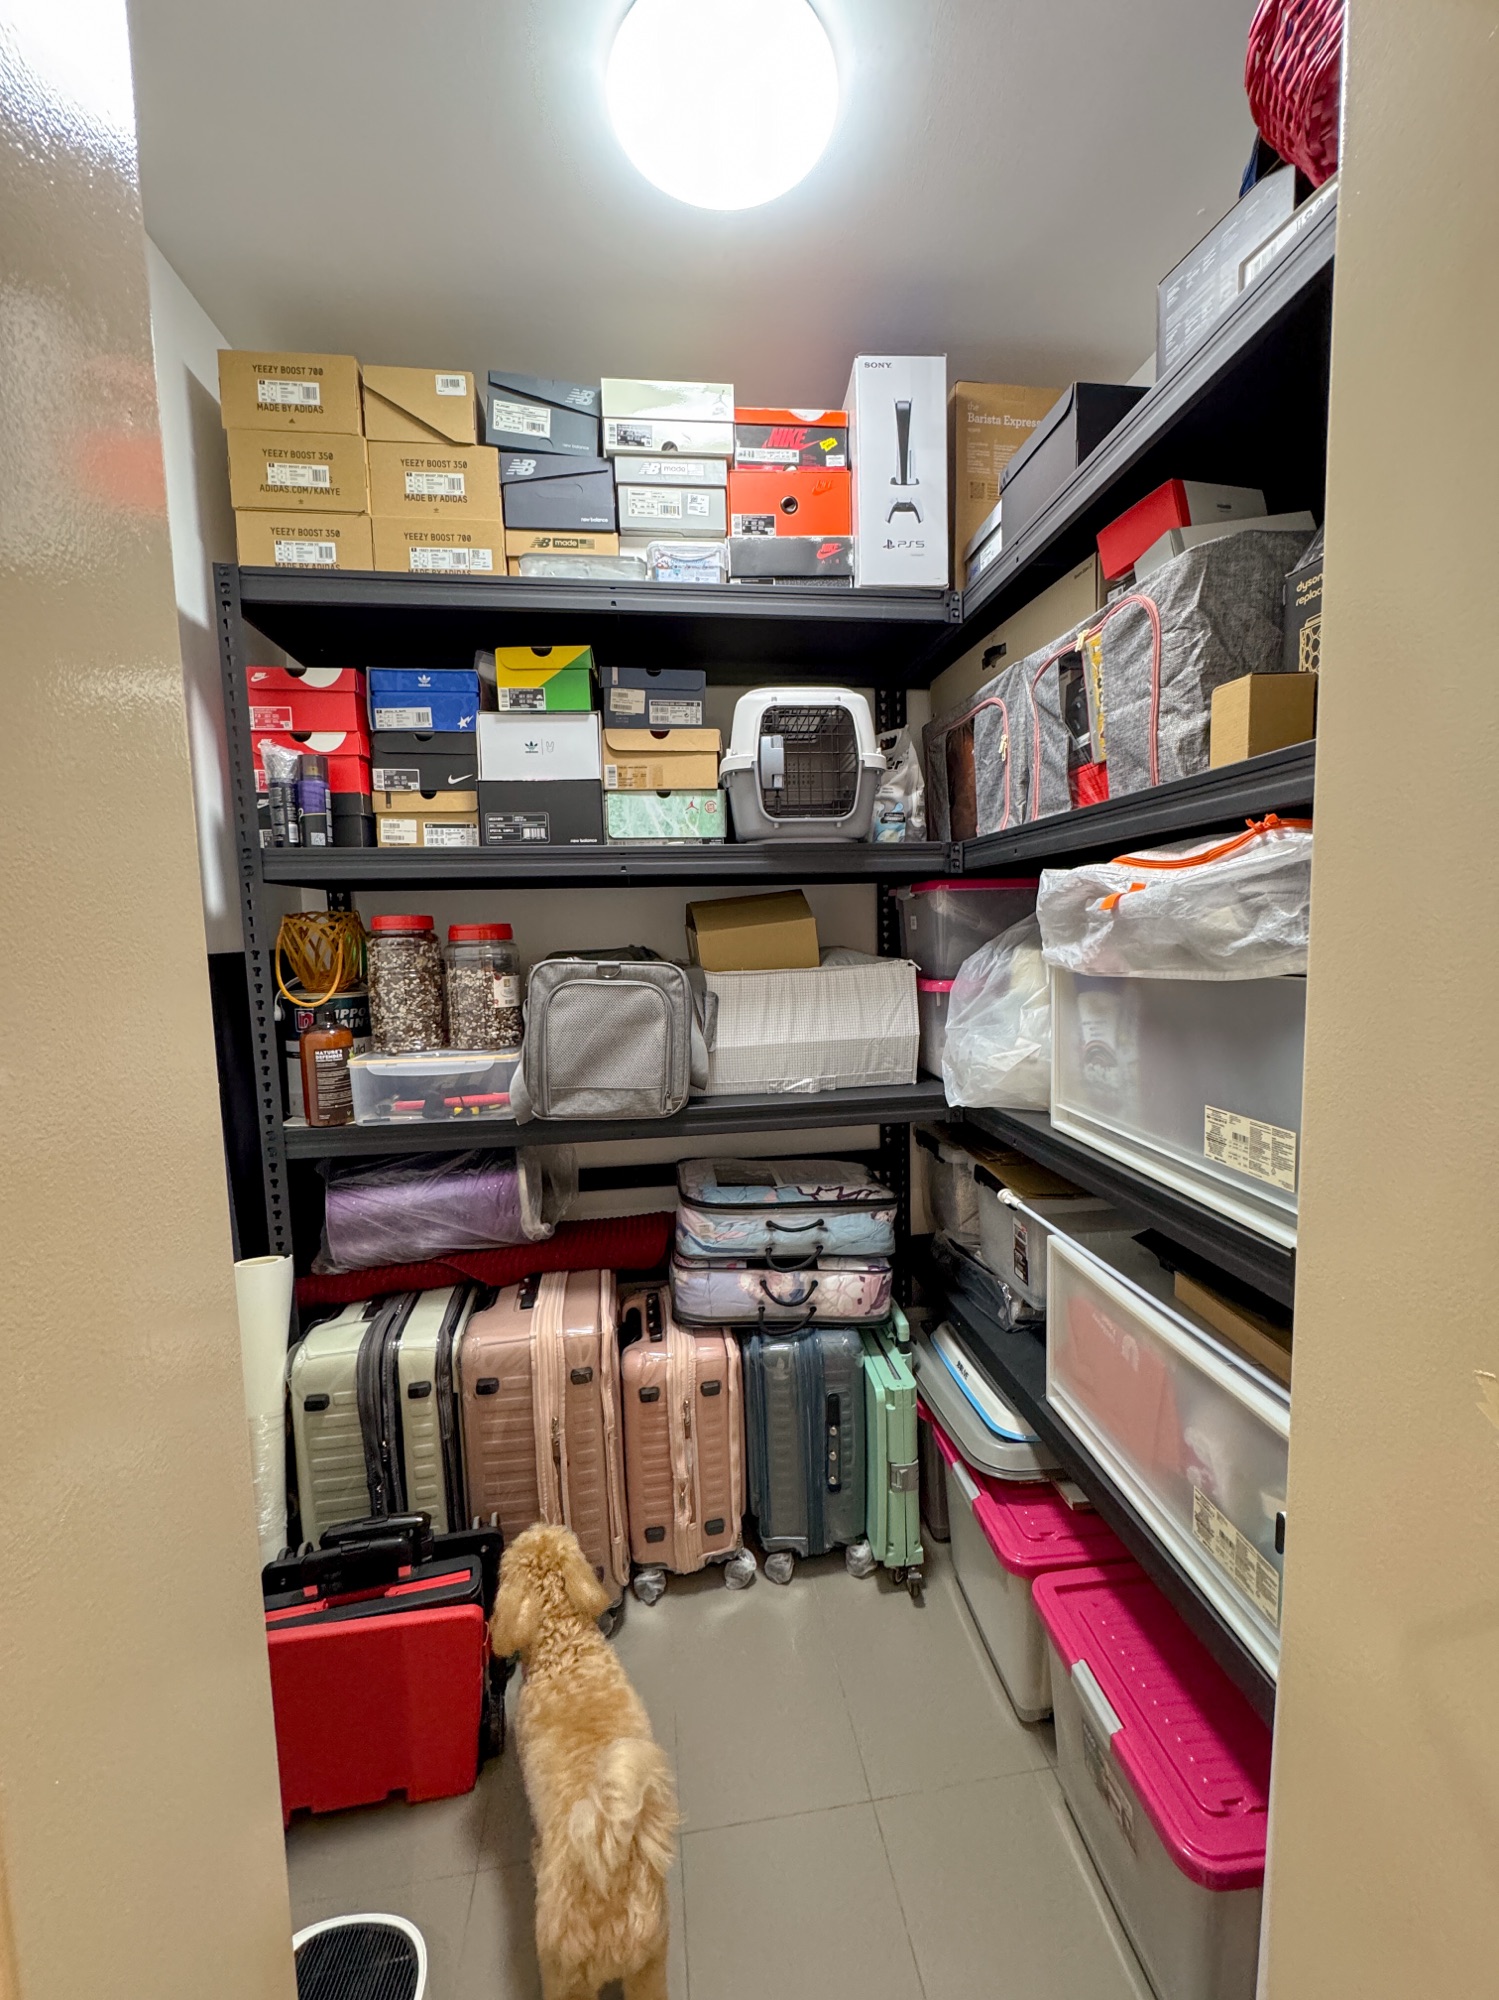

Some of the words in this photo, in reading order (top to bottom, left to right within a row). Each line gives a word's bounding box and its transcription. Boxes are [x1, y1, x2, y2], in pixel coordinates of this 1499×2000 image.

[252, 365, 278, 374] YEEZY
[280, 366, 306, 375] BOOST
[308, 368, 324, 376] 700
[257, 403, 279, 412] MADE
[282, 405, 291, 413] BY
[294, 405, 324, 414] ADIDAS
[967, 401, 979, 411] the
[967, 412, 1001, 424] Barista
[767, 427, 808, 447] NIKE
[262, 448, 288, 458] YEEZY
[290, 450, 316, 459] BOOST
[318, 452, 334, 460] 350
[401, 459, 425, 467] YEEZY
[427, 460, 451, 468] BOOST
[664, 464, 685, 472] made
[260, 484, 340, 496] ADIDAS.COM/KANYE
[404, 494, 425, 502] MADE
[428, 494, 438, 502] BY
[440, 495, 468, 503] ADIDAS
[270, 527, 296, 536] YEEZY
[298, 528, 323, 537] BOOST
[325, 530, 340, 538] 350
[404, 532, 428, 541] YEEZY
[431, 533, 455, 541] BOOST
[555, 539, 577, 547] made
[897, 540, 925, 548] PS5
[1296, 573, 1323, 592] dyson
[334, 1007, 366, 1019] IPPO
[337, 1017, 369, 1028] AIN
